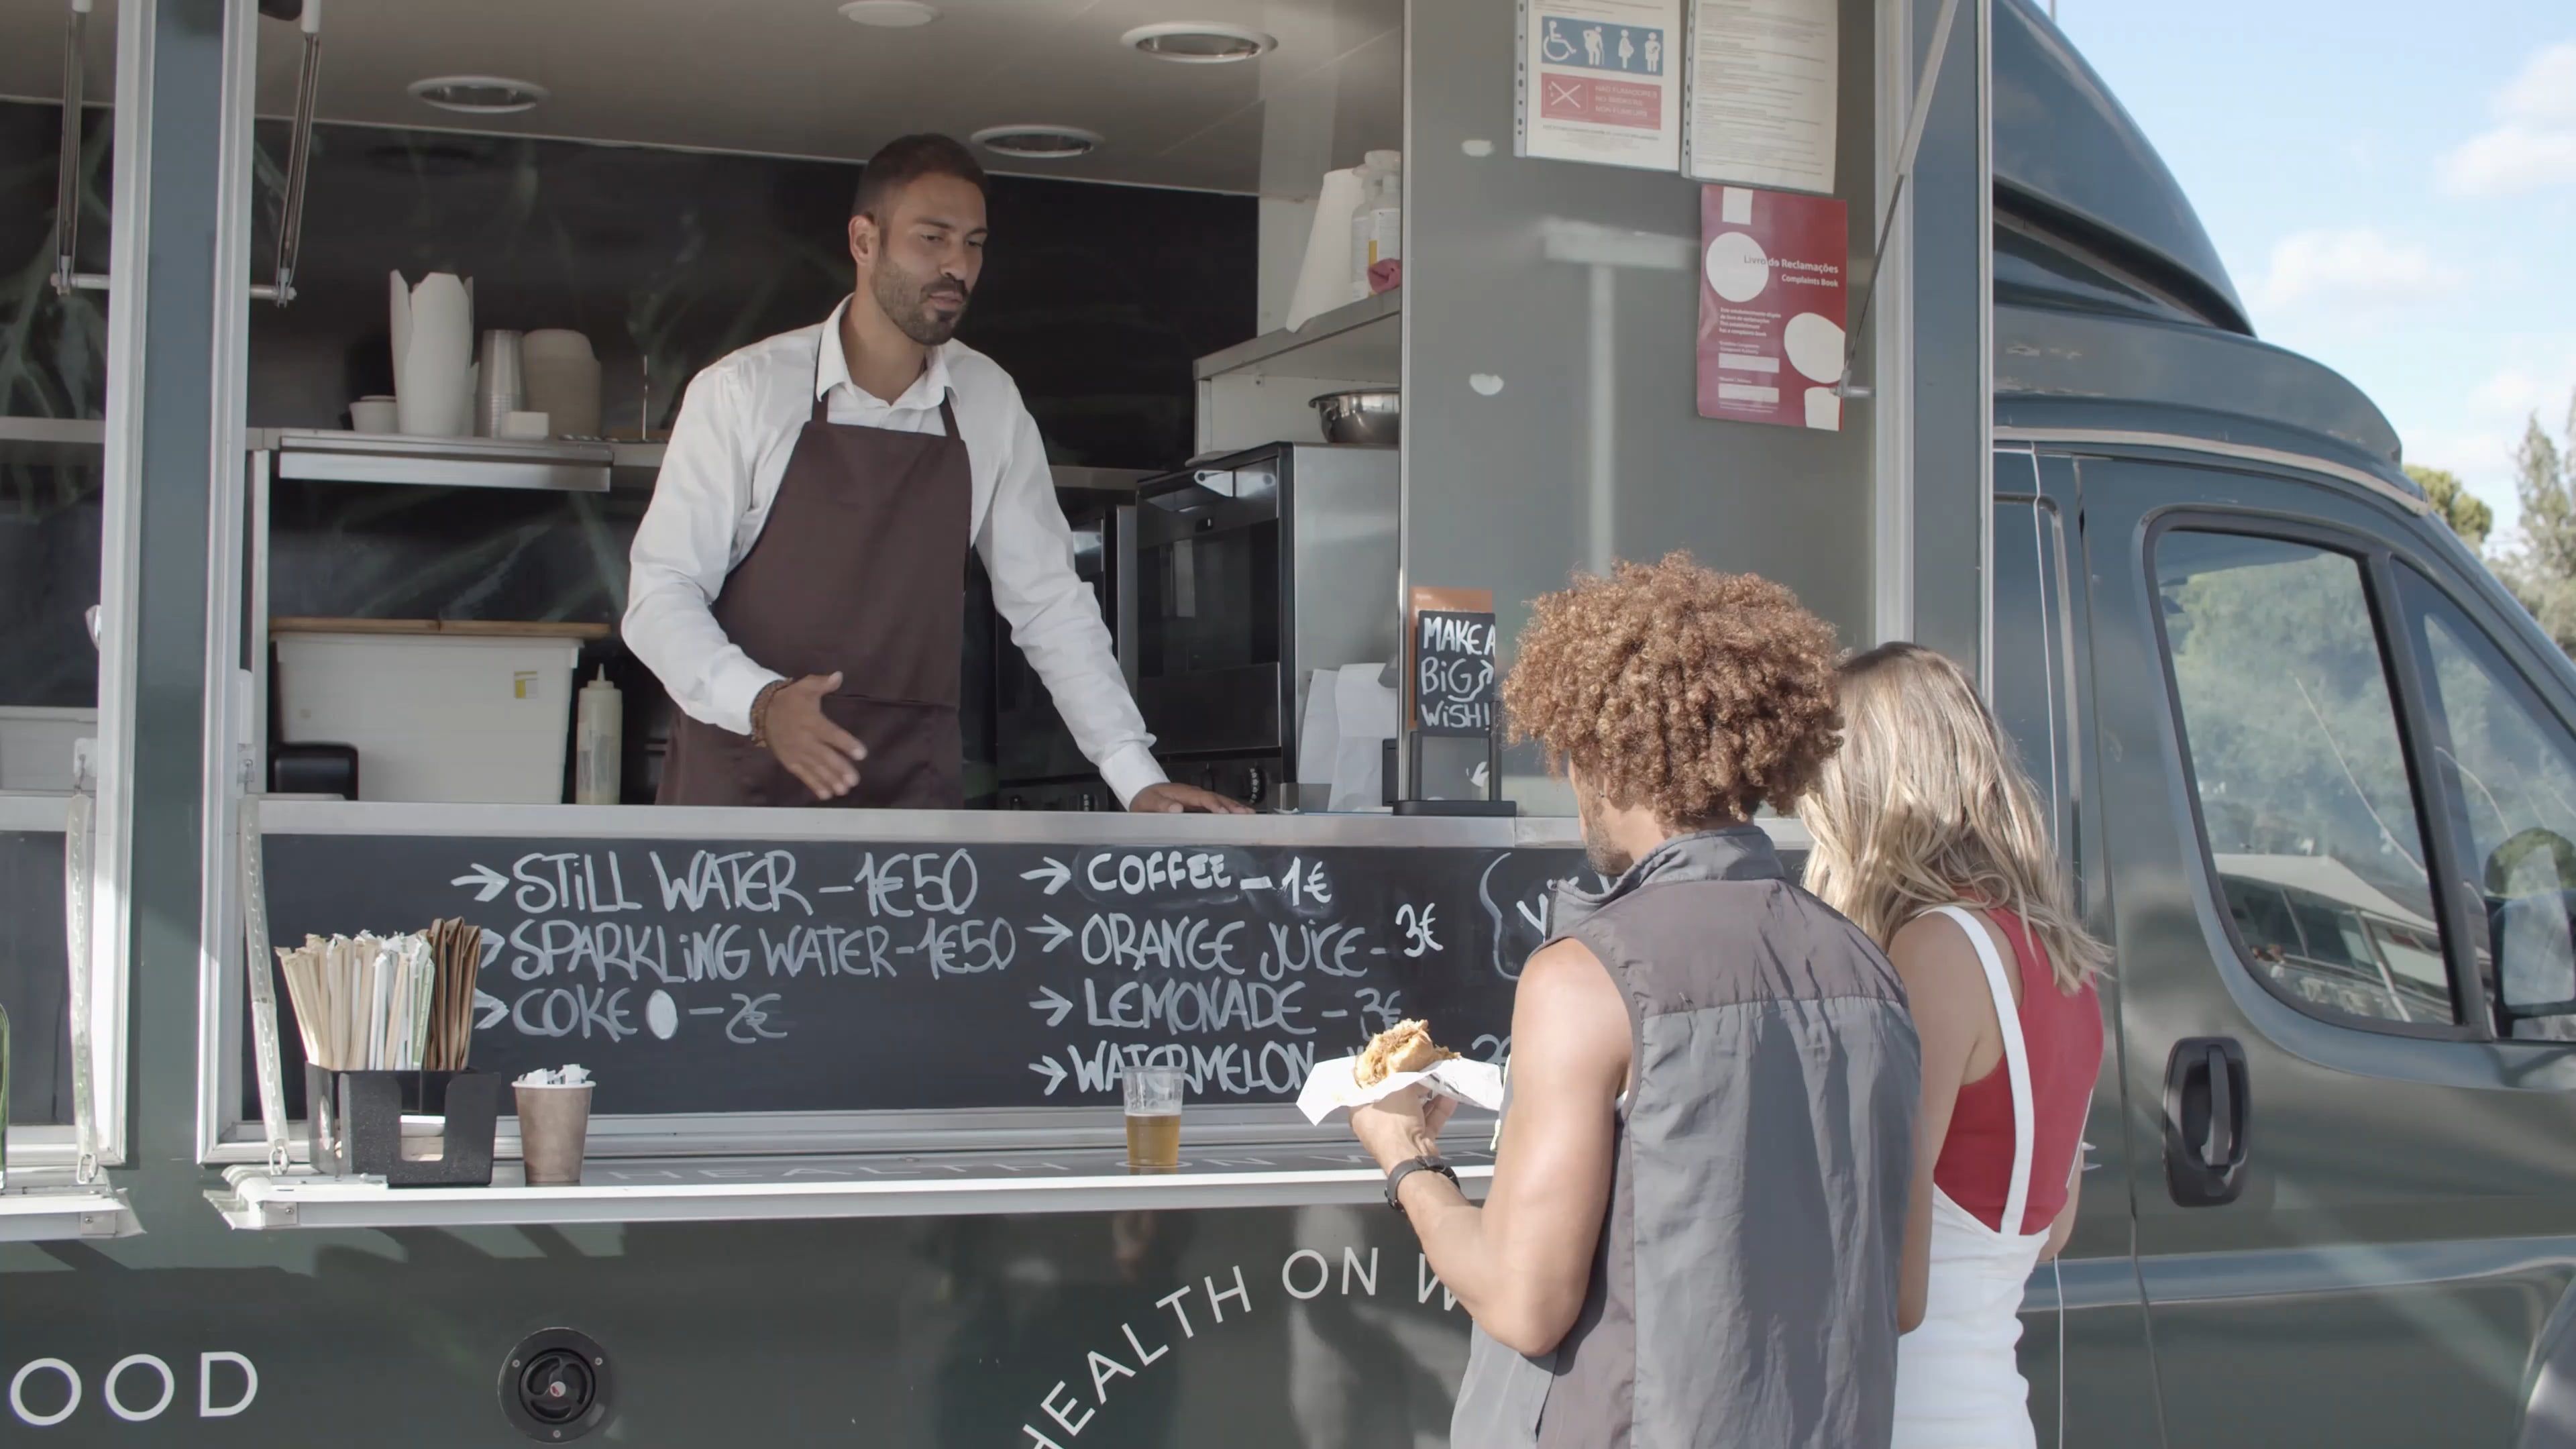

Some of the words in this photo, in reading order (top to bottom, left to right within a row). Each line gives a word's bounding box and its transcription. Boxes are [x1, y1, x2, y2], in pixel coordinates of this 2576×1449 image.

[1744, 255, 1766, 266] Livro
[1782, 259, 1839, 274] Reclamações
[1782, 274, 1820, 285] Complaints
[1821, 278, 1839, 287] Book
[1424, 616, 1482, 655] MAKE
[1483, 624, 1495, 656] A
[649, 850, 814, 916] WATER
[1087, 851, 1232, 895] COFFEE
[759, 924, 897, 978] WATER
[1081, 913, 1246, 976] ORANGE
[1395, 903, 1444, 957] 3€
[513, 983, 638, 1043] COKE
[1084, 977, 1318, 1036] LEMONADE
[1067, 1040, 1315, 1095] WATERMELON
[1283, 1246, 1379, 1299] ON
[10, 1351, 258, 1426] OOD
